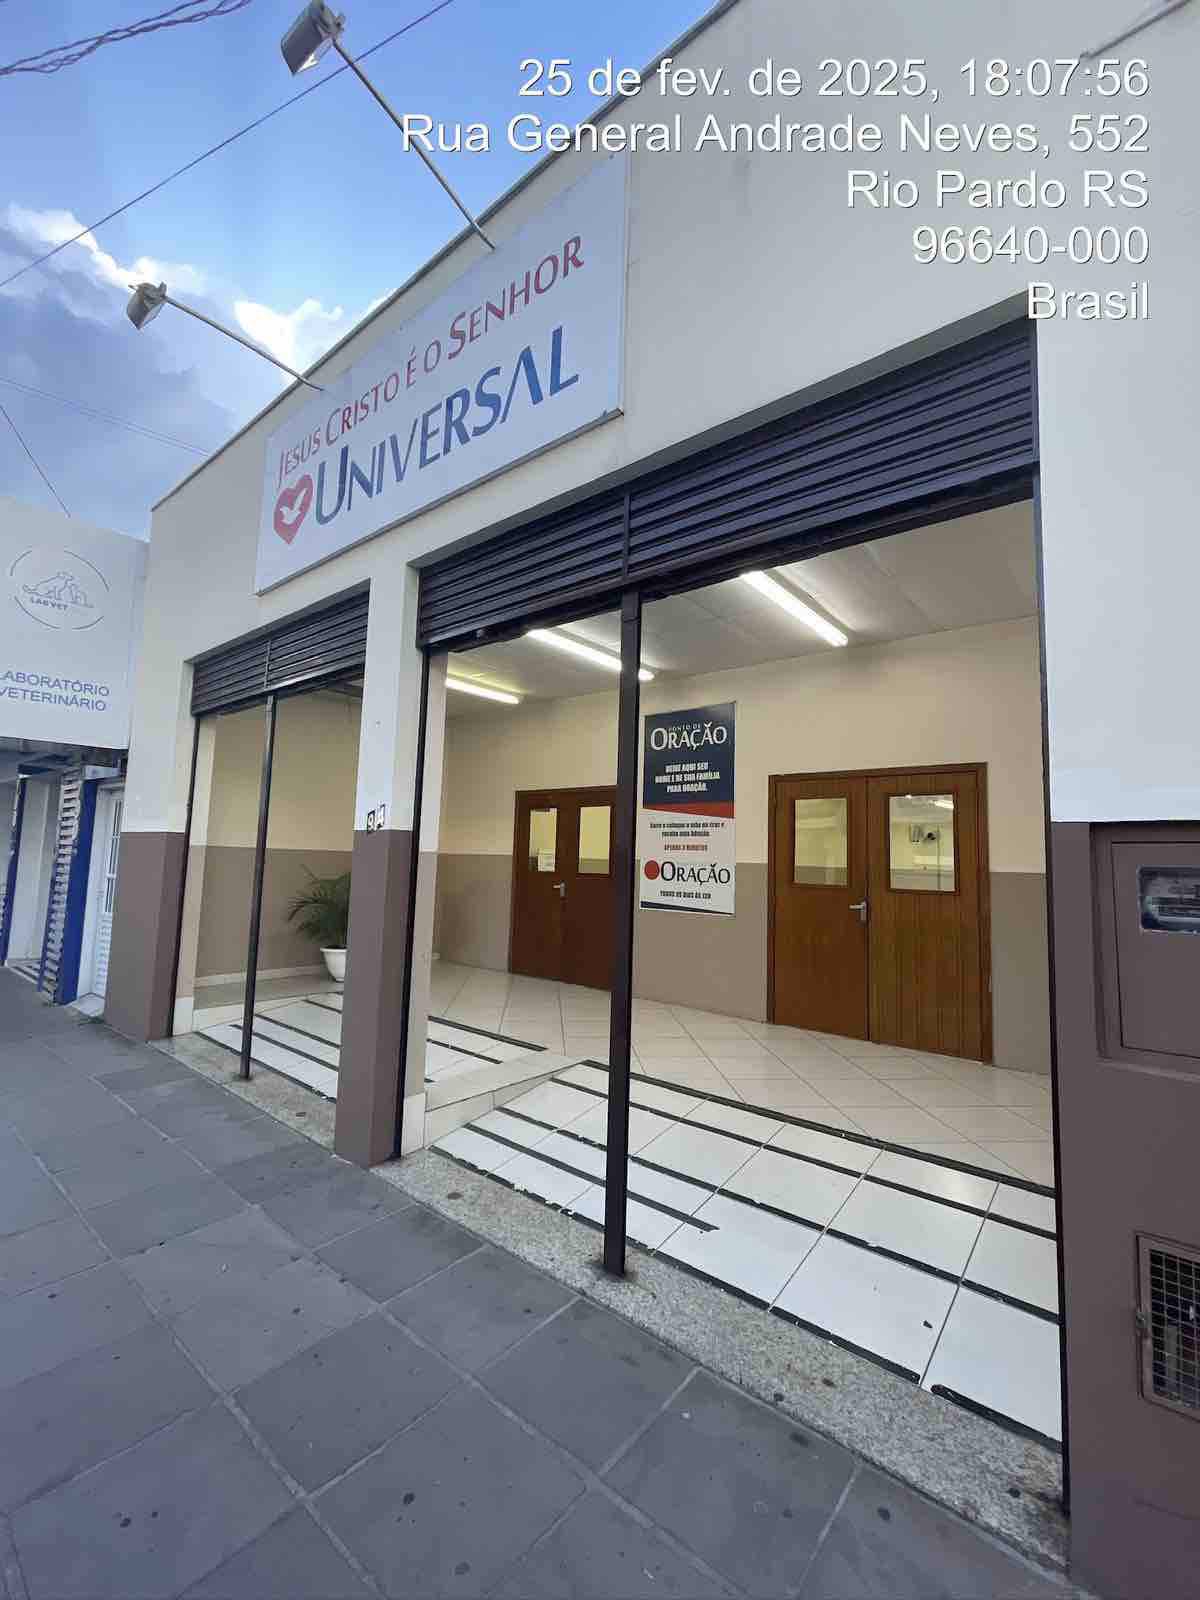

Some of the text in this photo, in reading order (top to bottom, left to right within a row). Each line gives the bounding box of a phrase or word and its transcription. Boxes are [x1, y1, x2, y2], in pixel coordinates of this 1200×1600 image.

[278, 235, 585, 490] JESUS CRISTO É O SENHOR
[314, 325, 580, 526] UNIVERSAL
[650, 721, 728, 751] ORAÇÃO
[660, 861, 731, 886] ORAÇÃO
